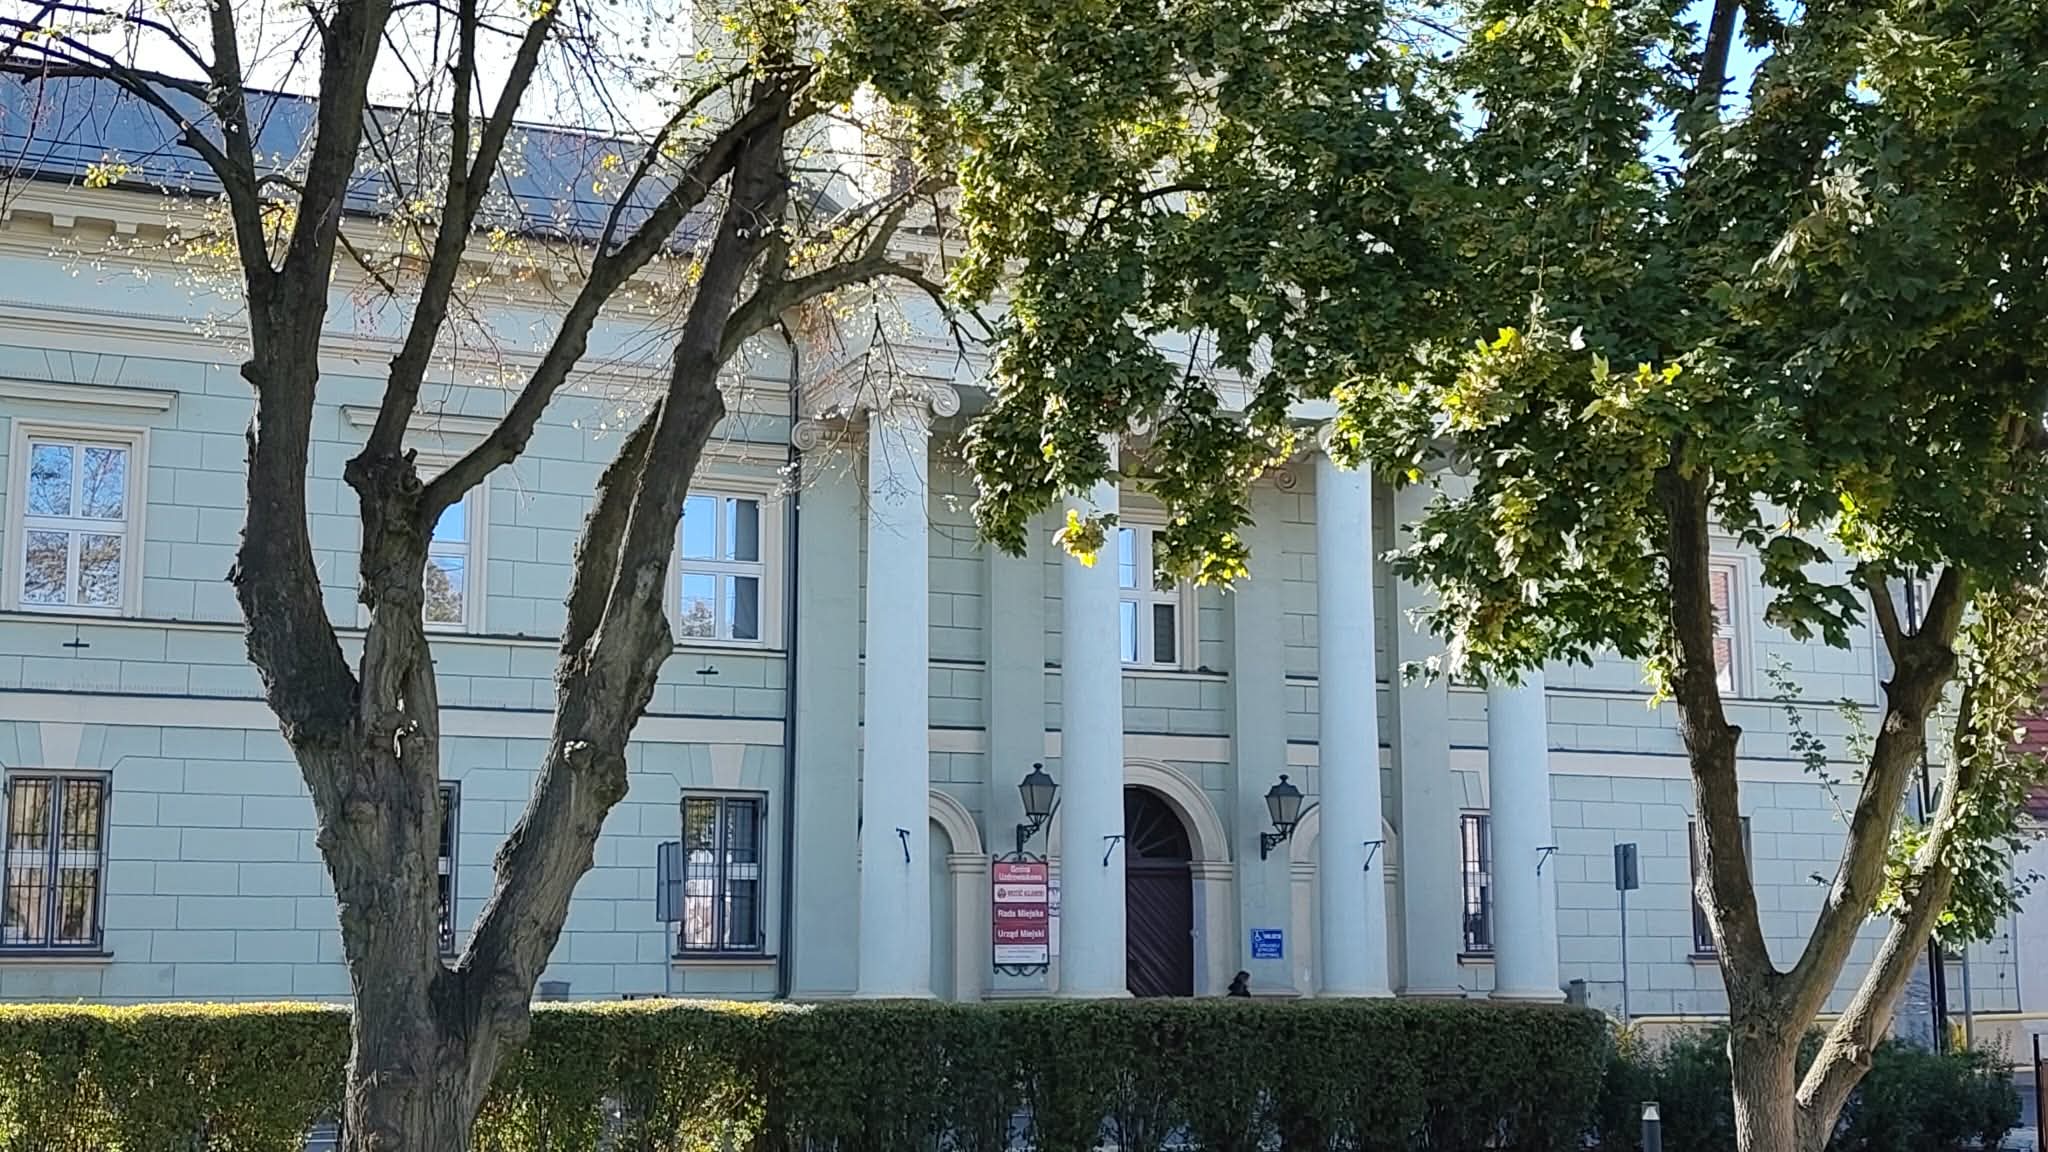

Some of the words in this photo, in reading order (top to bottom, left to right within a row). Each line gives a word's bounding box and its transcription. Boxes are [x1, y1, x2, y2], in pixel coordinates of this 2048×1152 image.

[997, 908, 1016, 918] Rada
[1017, 908, 1044, 920] Miejska
[997, 928, 1019, 940] Urząd
[1020, 928, 1045, 940] Miejski
